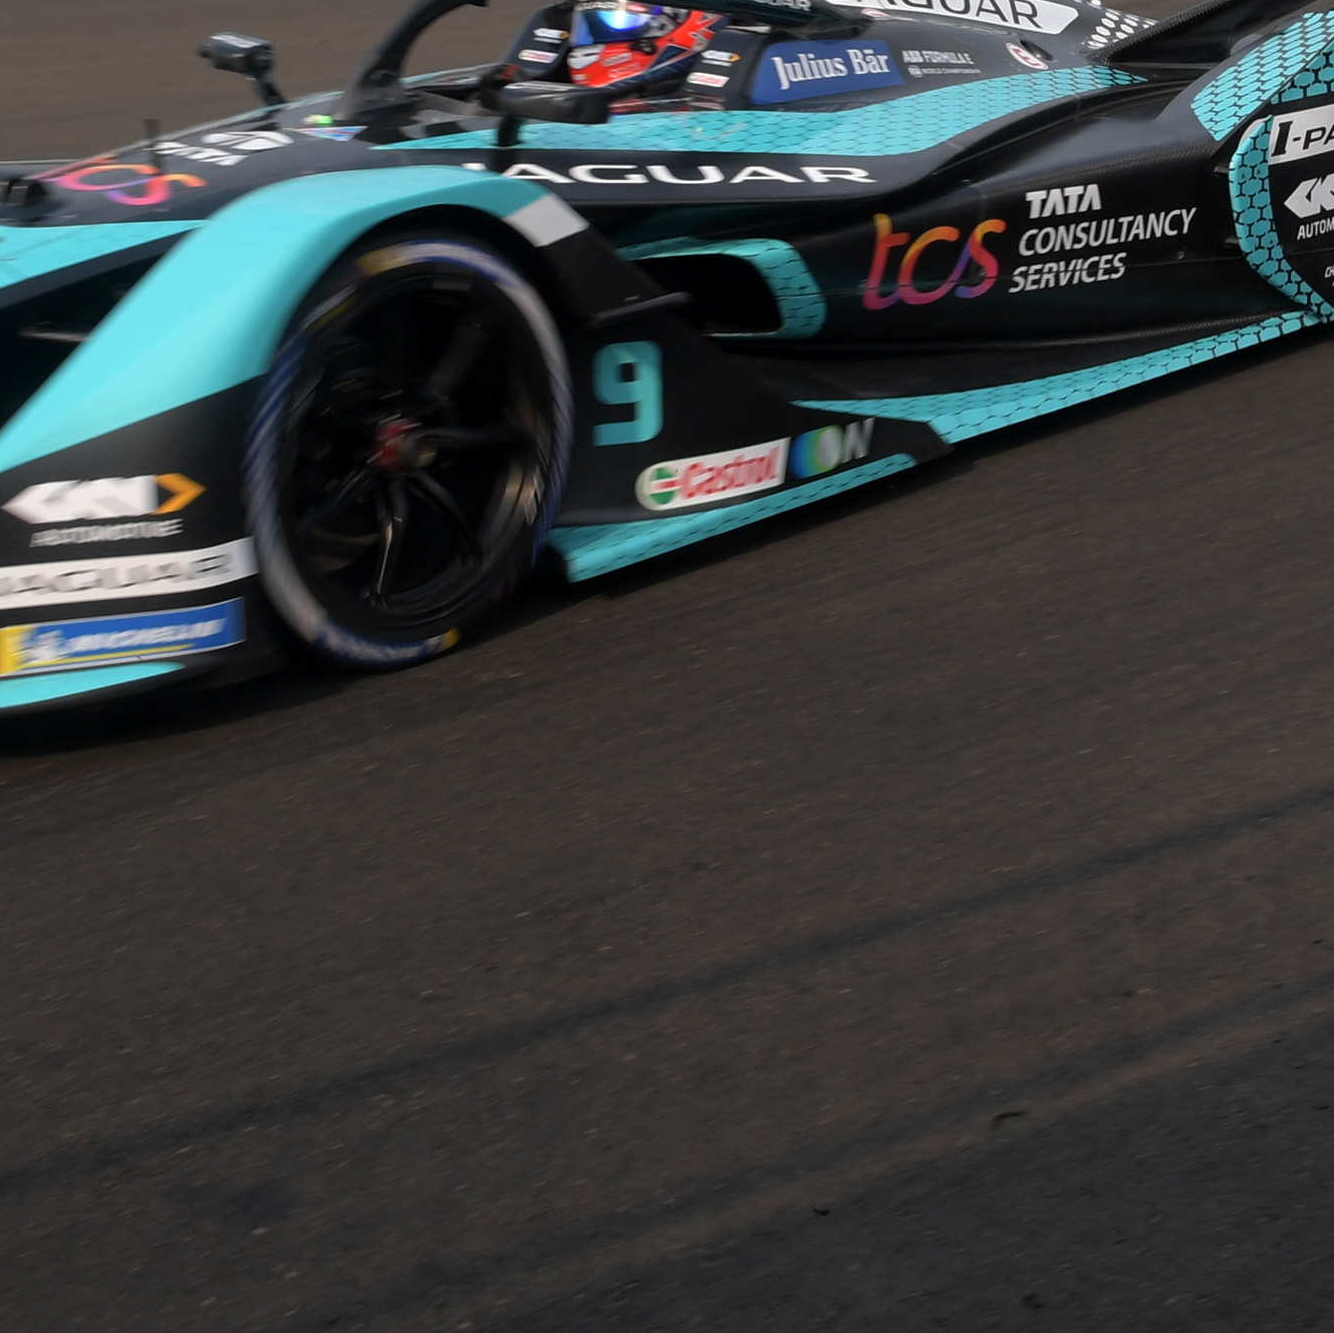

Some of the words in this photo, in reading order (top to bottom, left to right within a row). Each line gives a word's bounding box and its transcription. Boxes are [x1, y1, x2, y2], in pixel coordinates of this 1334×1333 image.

[771, 53, 849, 90] Julius
[846, 49, 891, 75] Bär
[463, 162, 878, 185] AGUAR
[1025, 183, 1102, 219] TATA
[1018, 207, 1197, 257] CONSULTANCY
[862, 213, 1007, 310] tcs
[1008, 252, 1127, 293] SERVICES
[592, 339, 664, 447] 9
[678, 445, 779, 501] Castrol
